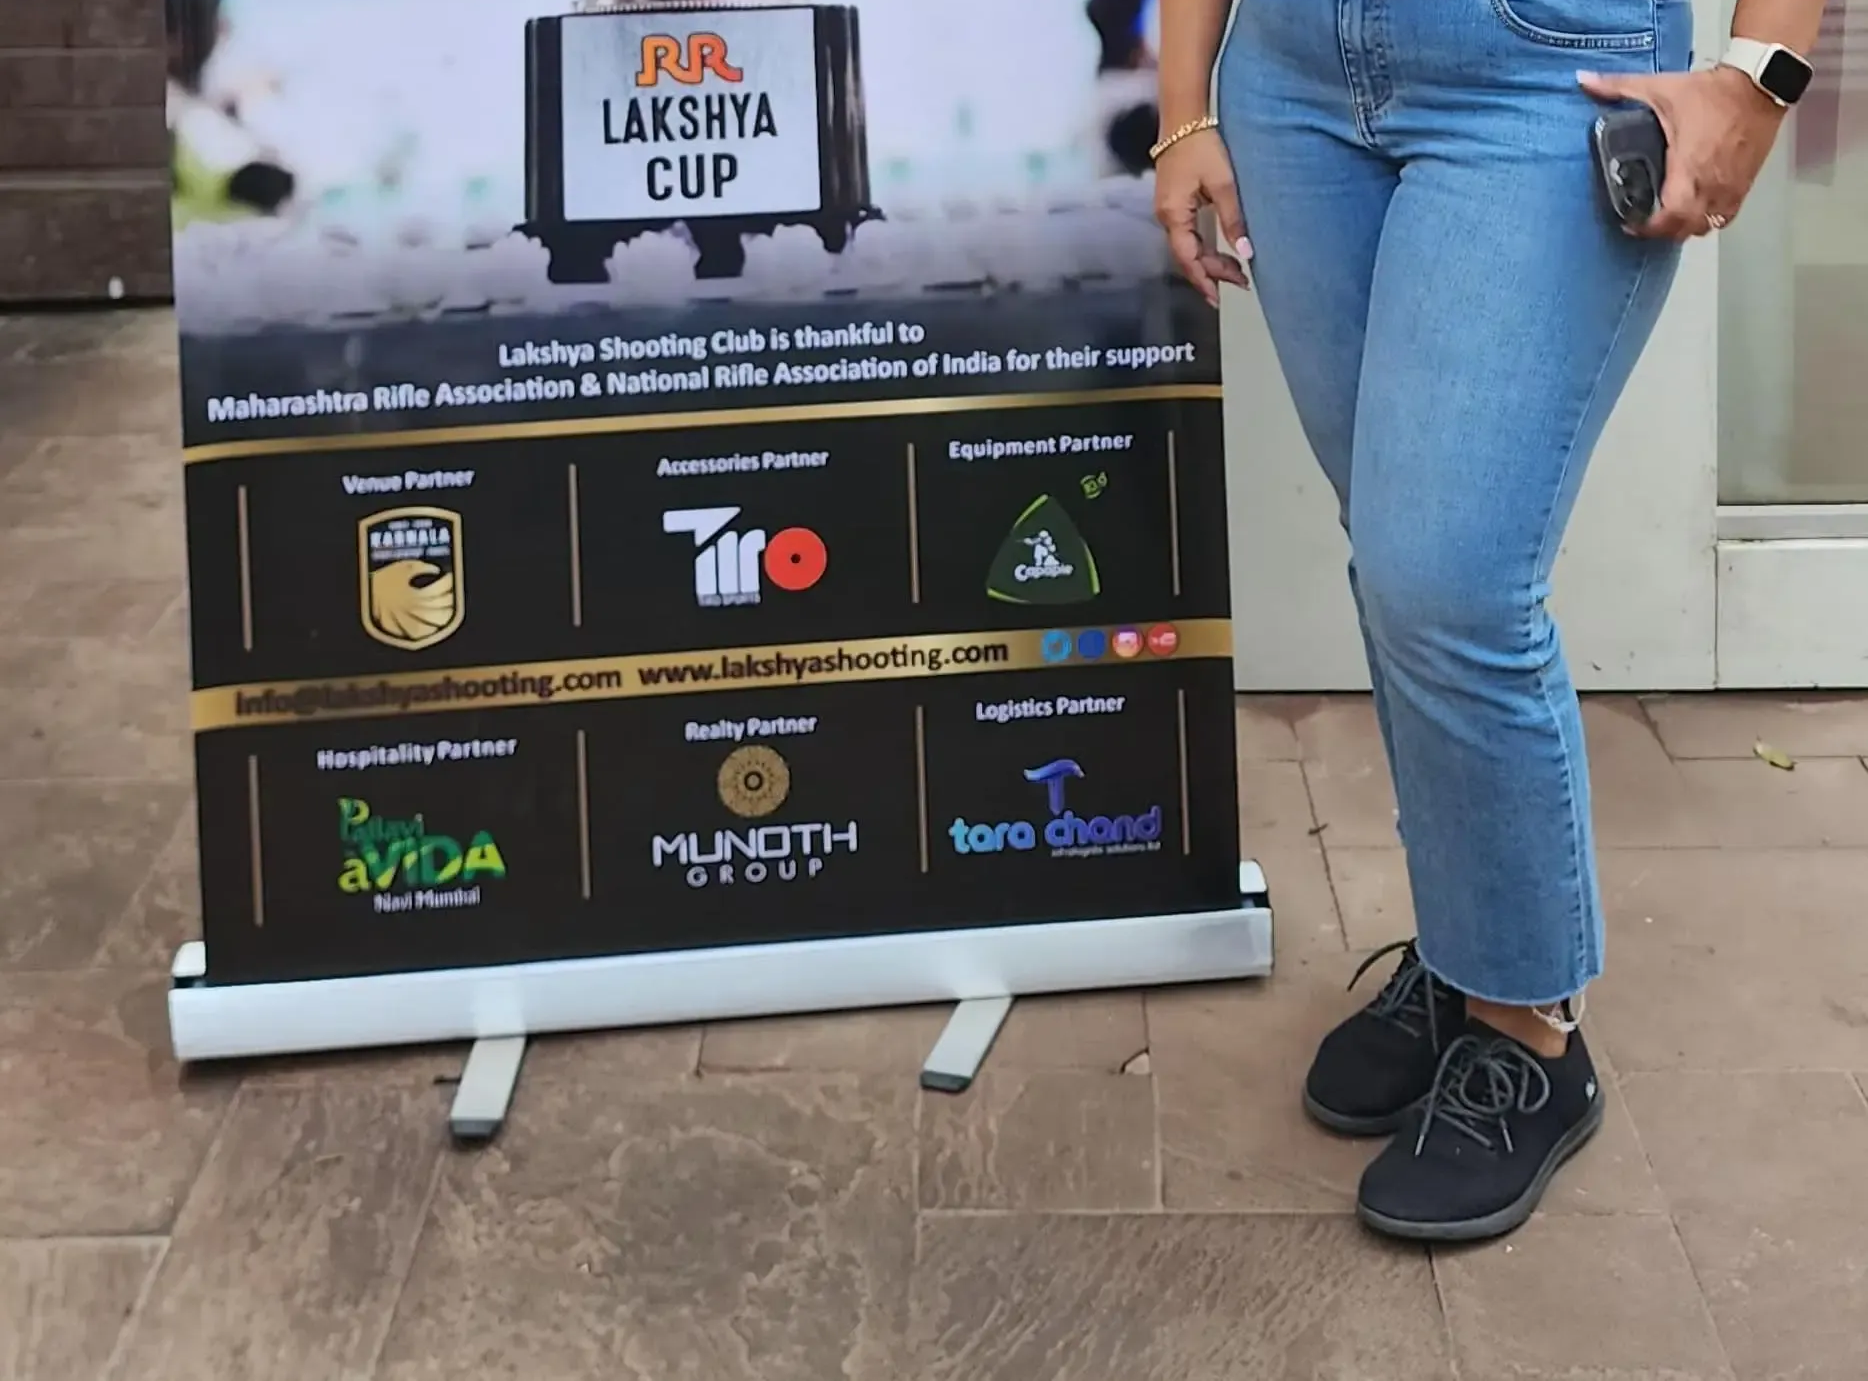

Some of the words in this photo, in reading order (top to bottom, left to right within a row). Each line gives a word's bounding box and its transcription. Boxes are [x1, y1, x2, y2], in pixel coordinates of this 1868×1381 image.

[635, 32, 743, 87] RR
[602, 92, 778, 145] LAKSHYA
[646, 153, 739, 201] CUP
[499, 338, 595, 369] Lakshya
[600, 332, 706, 361] Shooting
[711, 328, 765, 354] Club
[770, 327, 790, 350] is
[795, 321, 894, 349] thankful
[898, 322, 925, 345] to
[207, 389, 368, 422] Maharashtra
[373, 382, 431, 411] Rifle
[435, 375, 574, 407] Association
[581, 372, 602, 397] &
[607, 367, 709, 395] National
[714, 363, 769, 390] Rifle
[774, 357, 908, 385] Association
[912, 353, 940, 378] of
[943, 350, 1002, 375] India
[1007, 347, 1042, 372] for
[1045, 344, 1101, 370] their
[1106, 341, 1195, 371] support
[657, 450, 760, 477] Accessories
[762, 449, 830, 471] Partner
[948, 436, 1057, 462] Equipment
[1060, 431, 1134, 453] Partner
[342, 474, 401, 495] Venue
[405, 469, 475, 490] Partner
[637, 641, 1009, 686] www.lakshyashooting.com
[684, 718, 744, 743] Realty
[747, 714, 818, 739] Partner
[976, 698, 1053, 724] Logistics
[1056, 694, 1126, 717] Partner
[316, 743, 434, 771] Hospitality
[437, 736, 518, 760] Partner
[652, 821, 859, 868] MUNOTH
[948, 817, 1036, 854] tara
[1045, 805, 1162, 847] chand
[686, 857, 824, 888] GROUP
[373, 891, 413, 913] Navi
[415, 885, 482, 910] Mumbai
